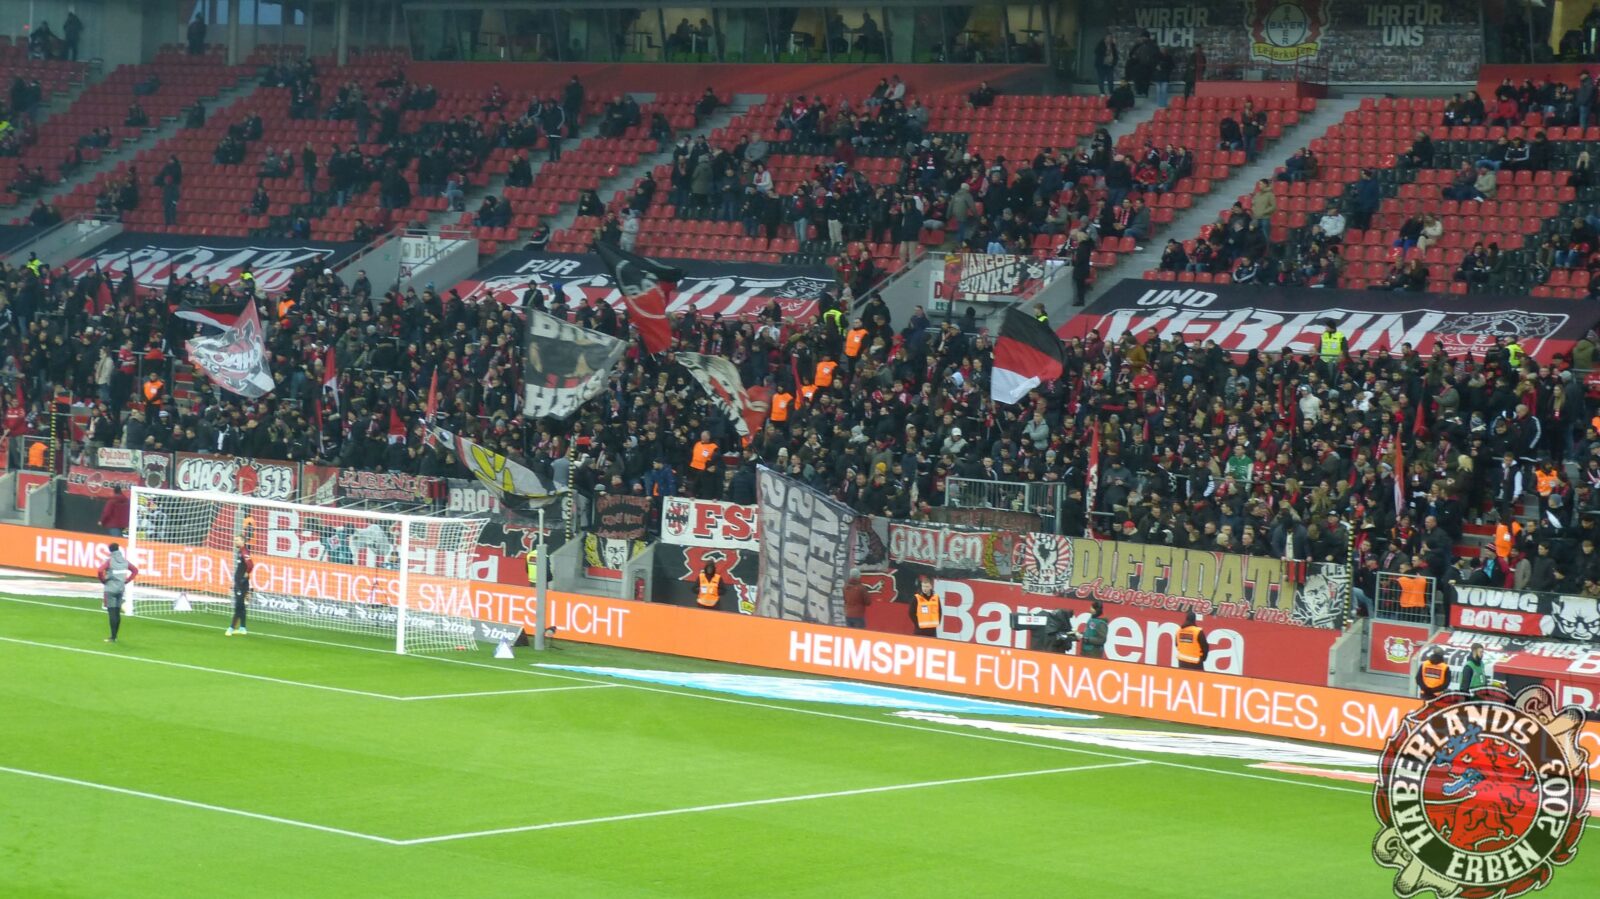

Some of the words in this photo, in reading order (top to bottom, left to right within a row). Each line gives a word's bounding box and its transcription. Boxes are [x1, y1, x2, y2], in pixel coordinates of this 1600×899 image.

[1135, 7, 1171, 27] WIR
[1172, 4, 1209, 27] FÜR
[1367, 4, 1400, 26] IHR
[515, 258, 581, 275] FÜR
[1136, 289, 1218, 308] UND
[1103, 308, 1447, 353] VEREIN
[177, 458, 235, 492] CHAOS
[259, 465, 293, 500] 513
[168, 548, 213, 584] FÜR
[418, 583, 537, 626] SMARTES
[551, 599, 631, 638] LICHT
[1075, 578, 1213, 615] Ausgesperrte
[1217, 602, 1250, 619] mit
[1454, 585, 1539, 613] YOUNG
[1460, 608, 1524, 632] BOYS
[788, 630, 967, 684] HEIMSPIEL
[975, 650, 1041, 693] FÜR
[1050, 664, 1326, 737] NACHHALTIGES,
